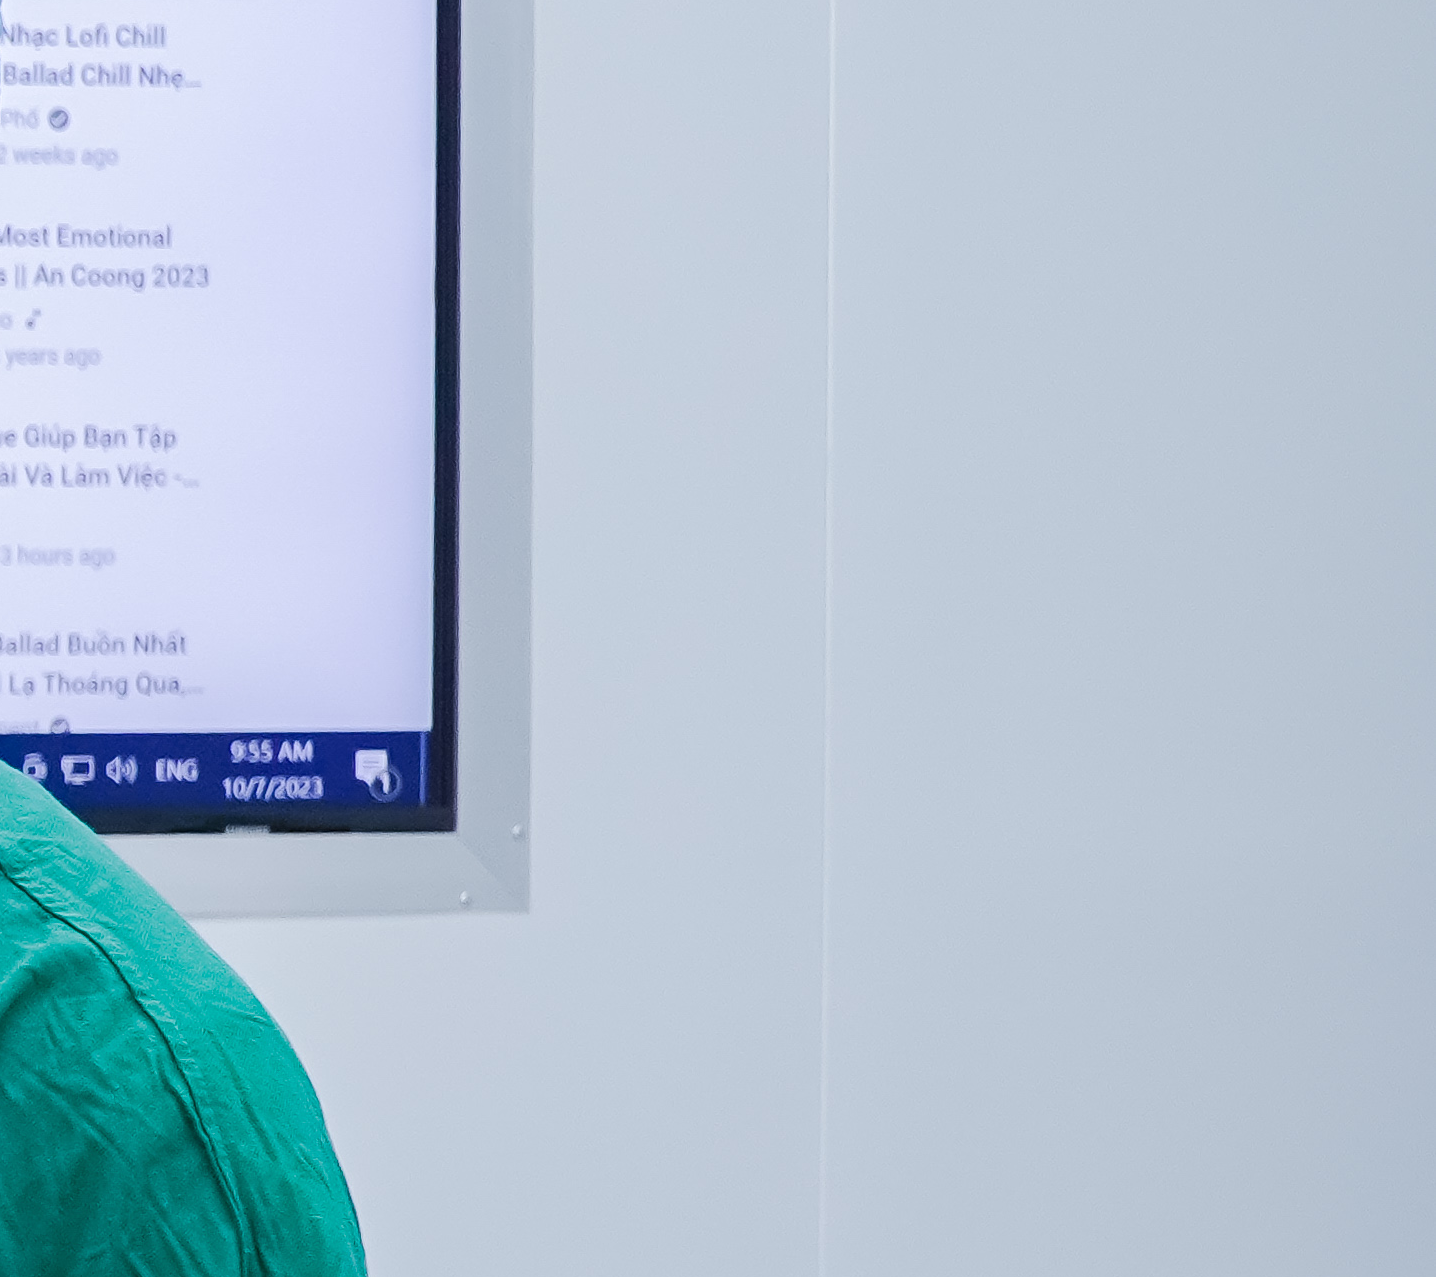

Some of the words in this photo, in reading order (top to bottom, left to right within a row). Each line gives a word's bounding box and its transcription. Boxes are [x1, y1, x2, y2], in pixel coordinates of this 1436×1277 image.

[65, 23, 110, 48] Lofi
[116, 24, 168, 48] Chill
[2, 61, 74, 87] Ballad
[81, 62, 132, 87] Chill
[12, 144, 76, 165] weeks
[81, 148, 119, 171] ago
[56, 223, 172, 249] Emotional
[33, 263, 64, 287] An
[152, 264, 210, 288] 2023
[4, 347, 59, 370] years
[63, 348, 102, 371] ago
[17, 545, 74, 566] hours
[78, 547, 116, 571] ago
[230, 739, 273, 764] 9:55
[278, 739, 314, 763] AM
[155, 757, 199, 782] ENG
[222, 775, 324, 802] 10/7/2023
